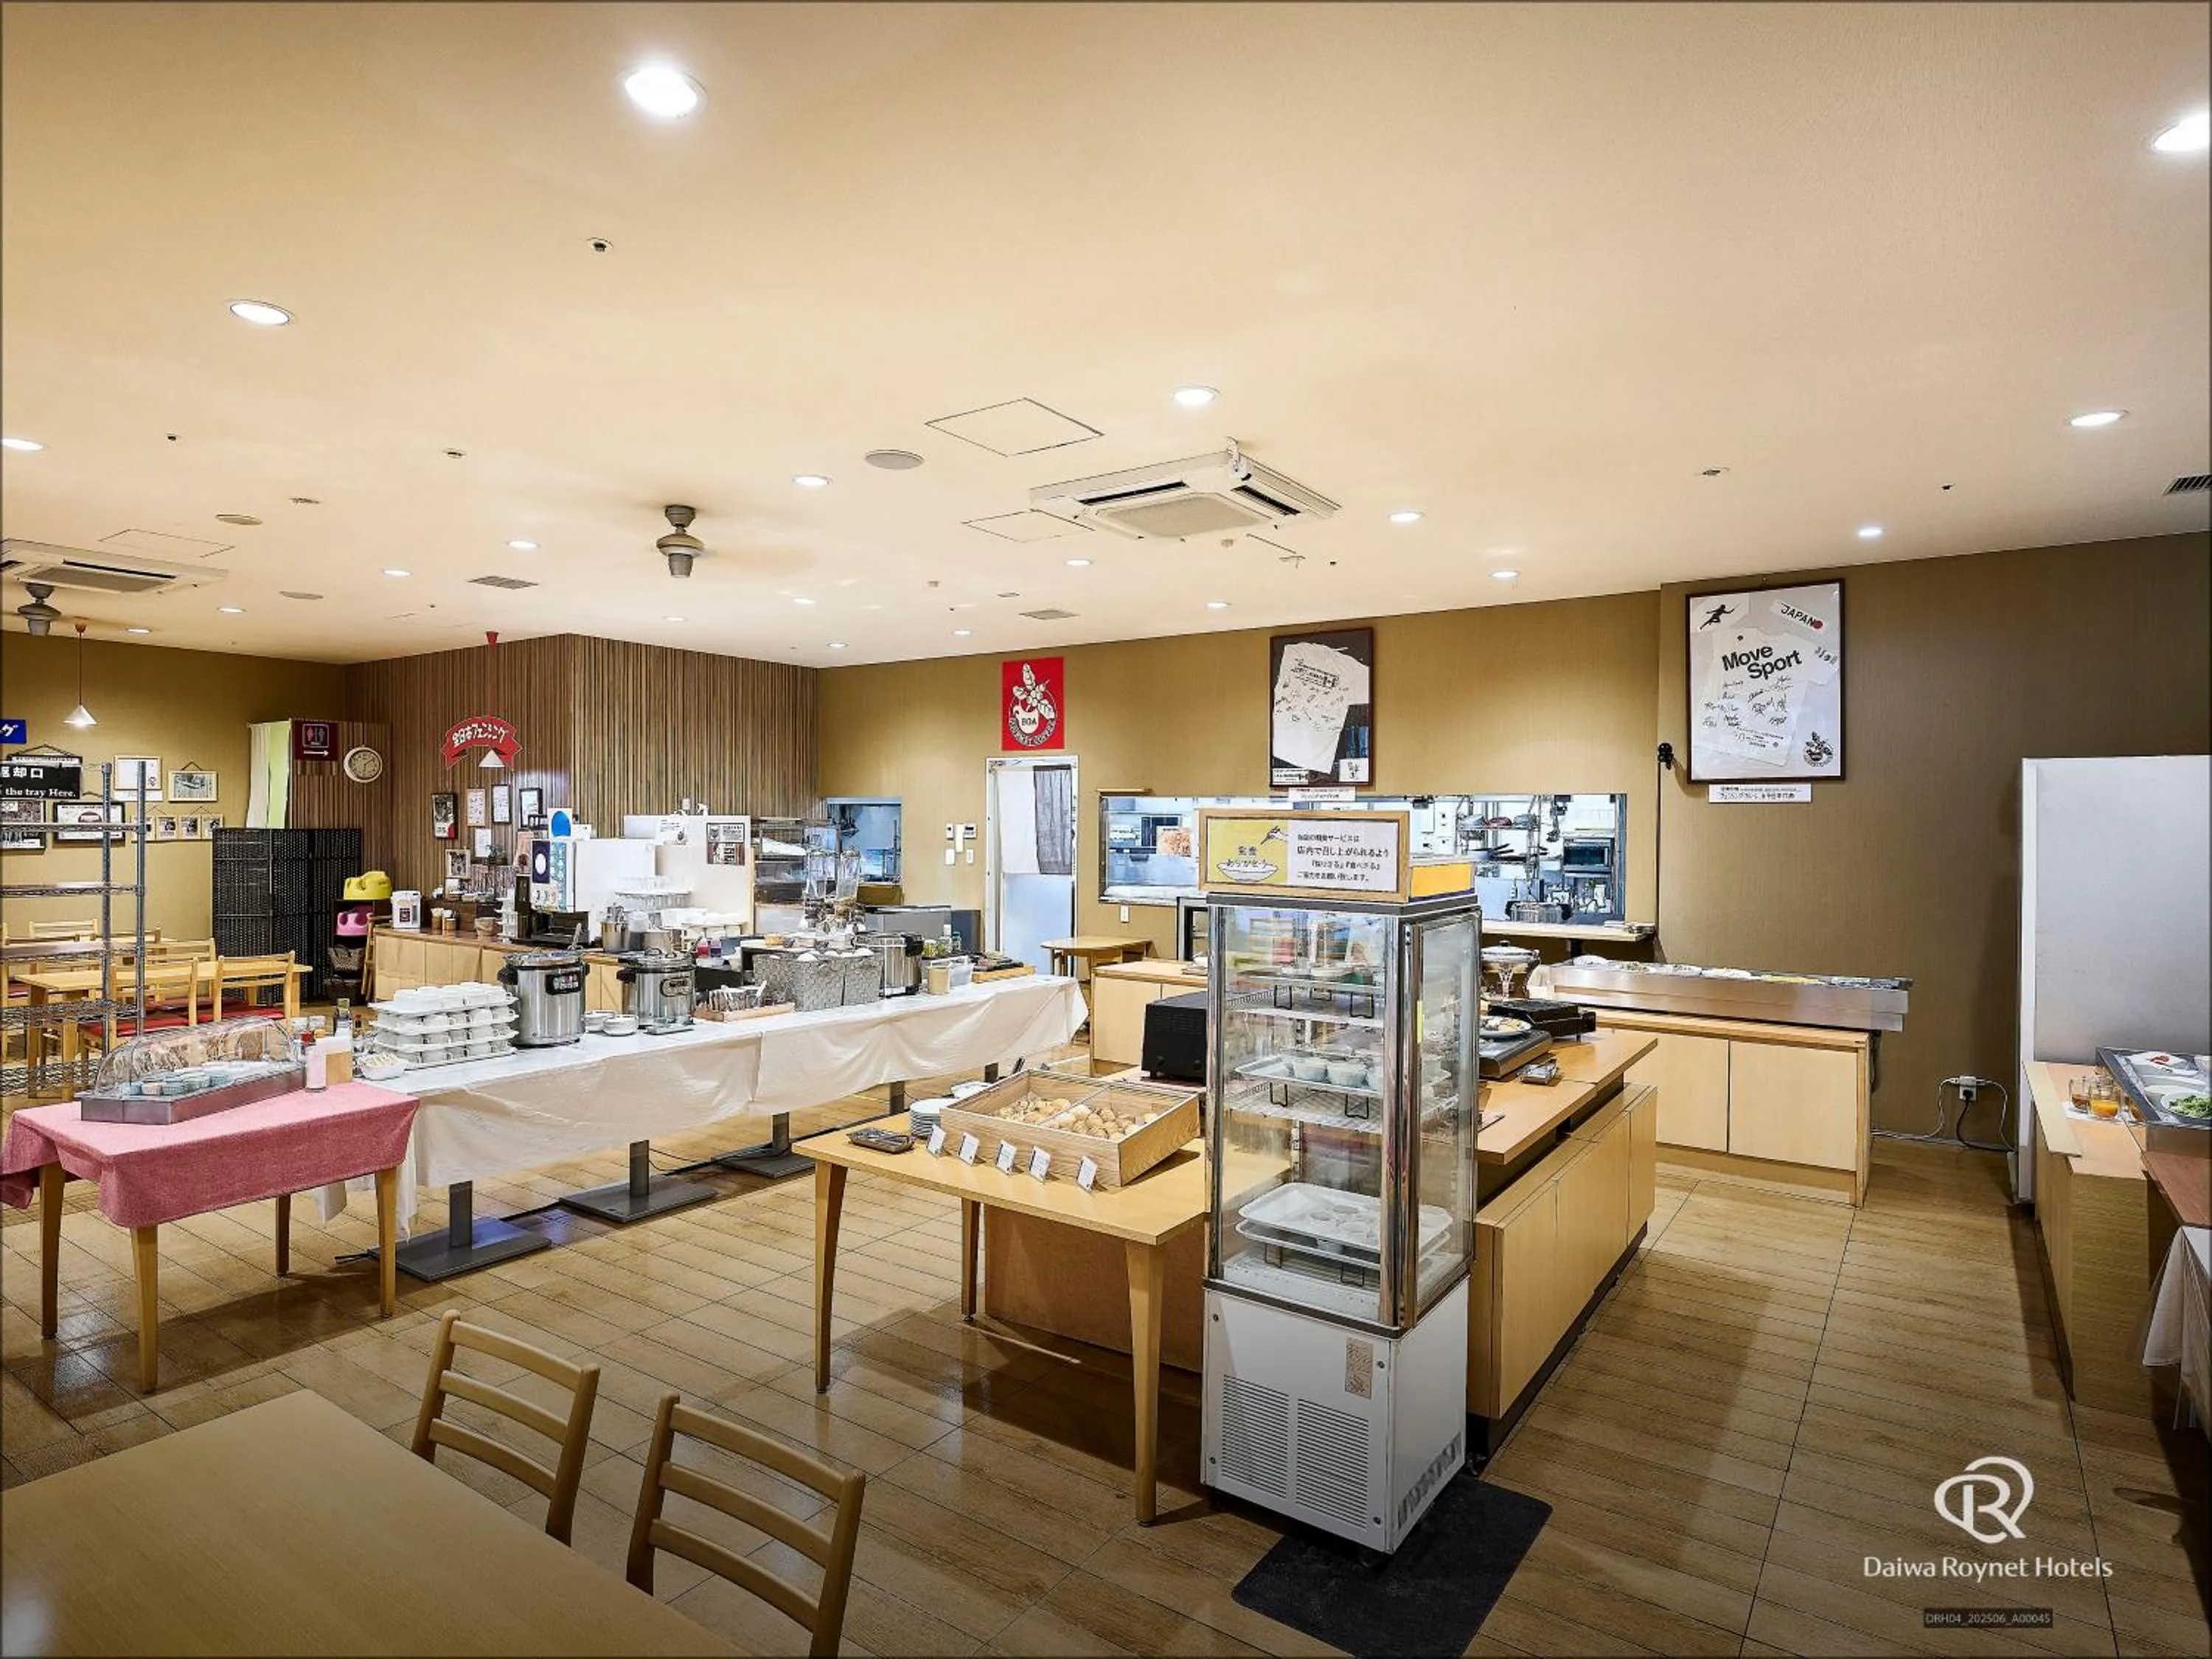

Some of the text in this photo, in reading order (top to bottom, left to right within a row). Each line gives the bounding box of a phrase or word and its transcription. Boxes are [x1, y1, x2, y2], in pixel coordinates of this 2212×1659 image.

[1781, 602, 1816, 627] JAPAN
[1722, 646, 1773, 671] Move
[1747, 650, 1802, 680] Sport
[0, 724, 18, 737] グ
[5, 787, 76, 798] the tray Here.
